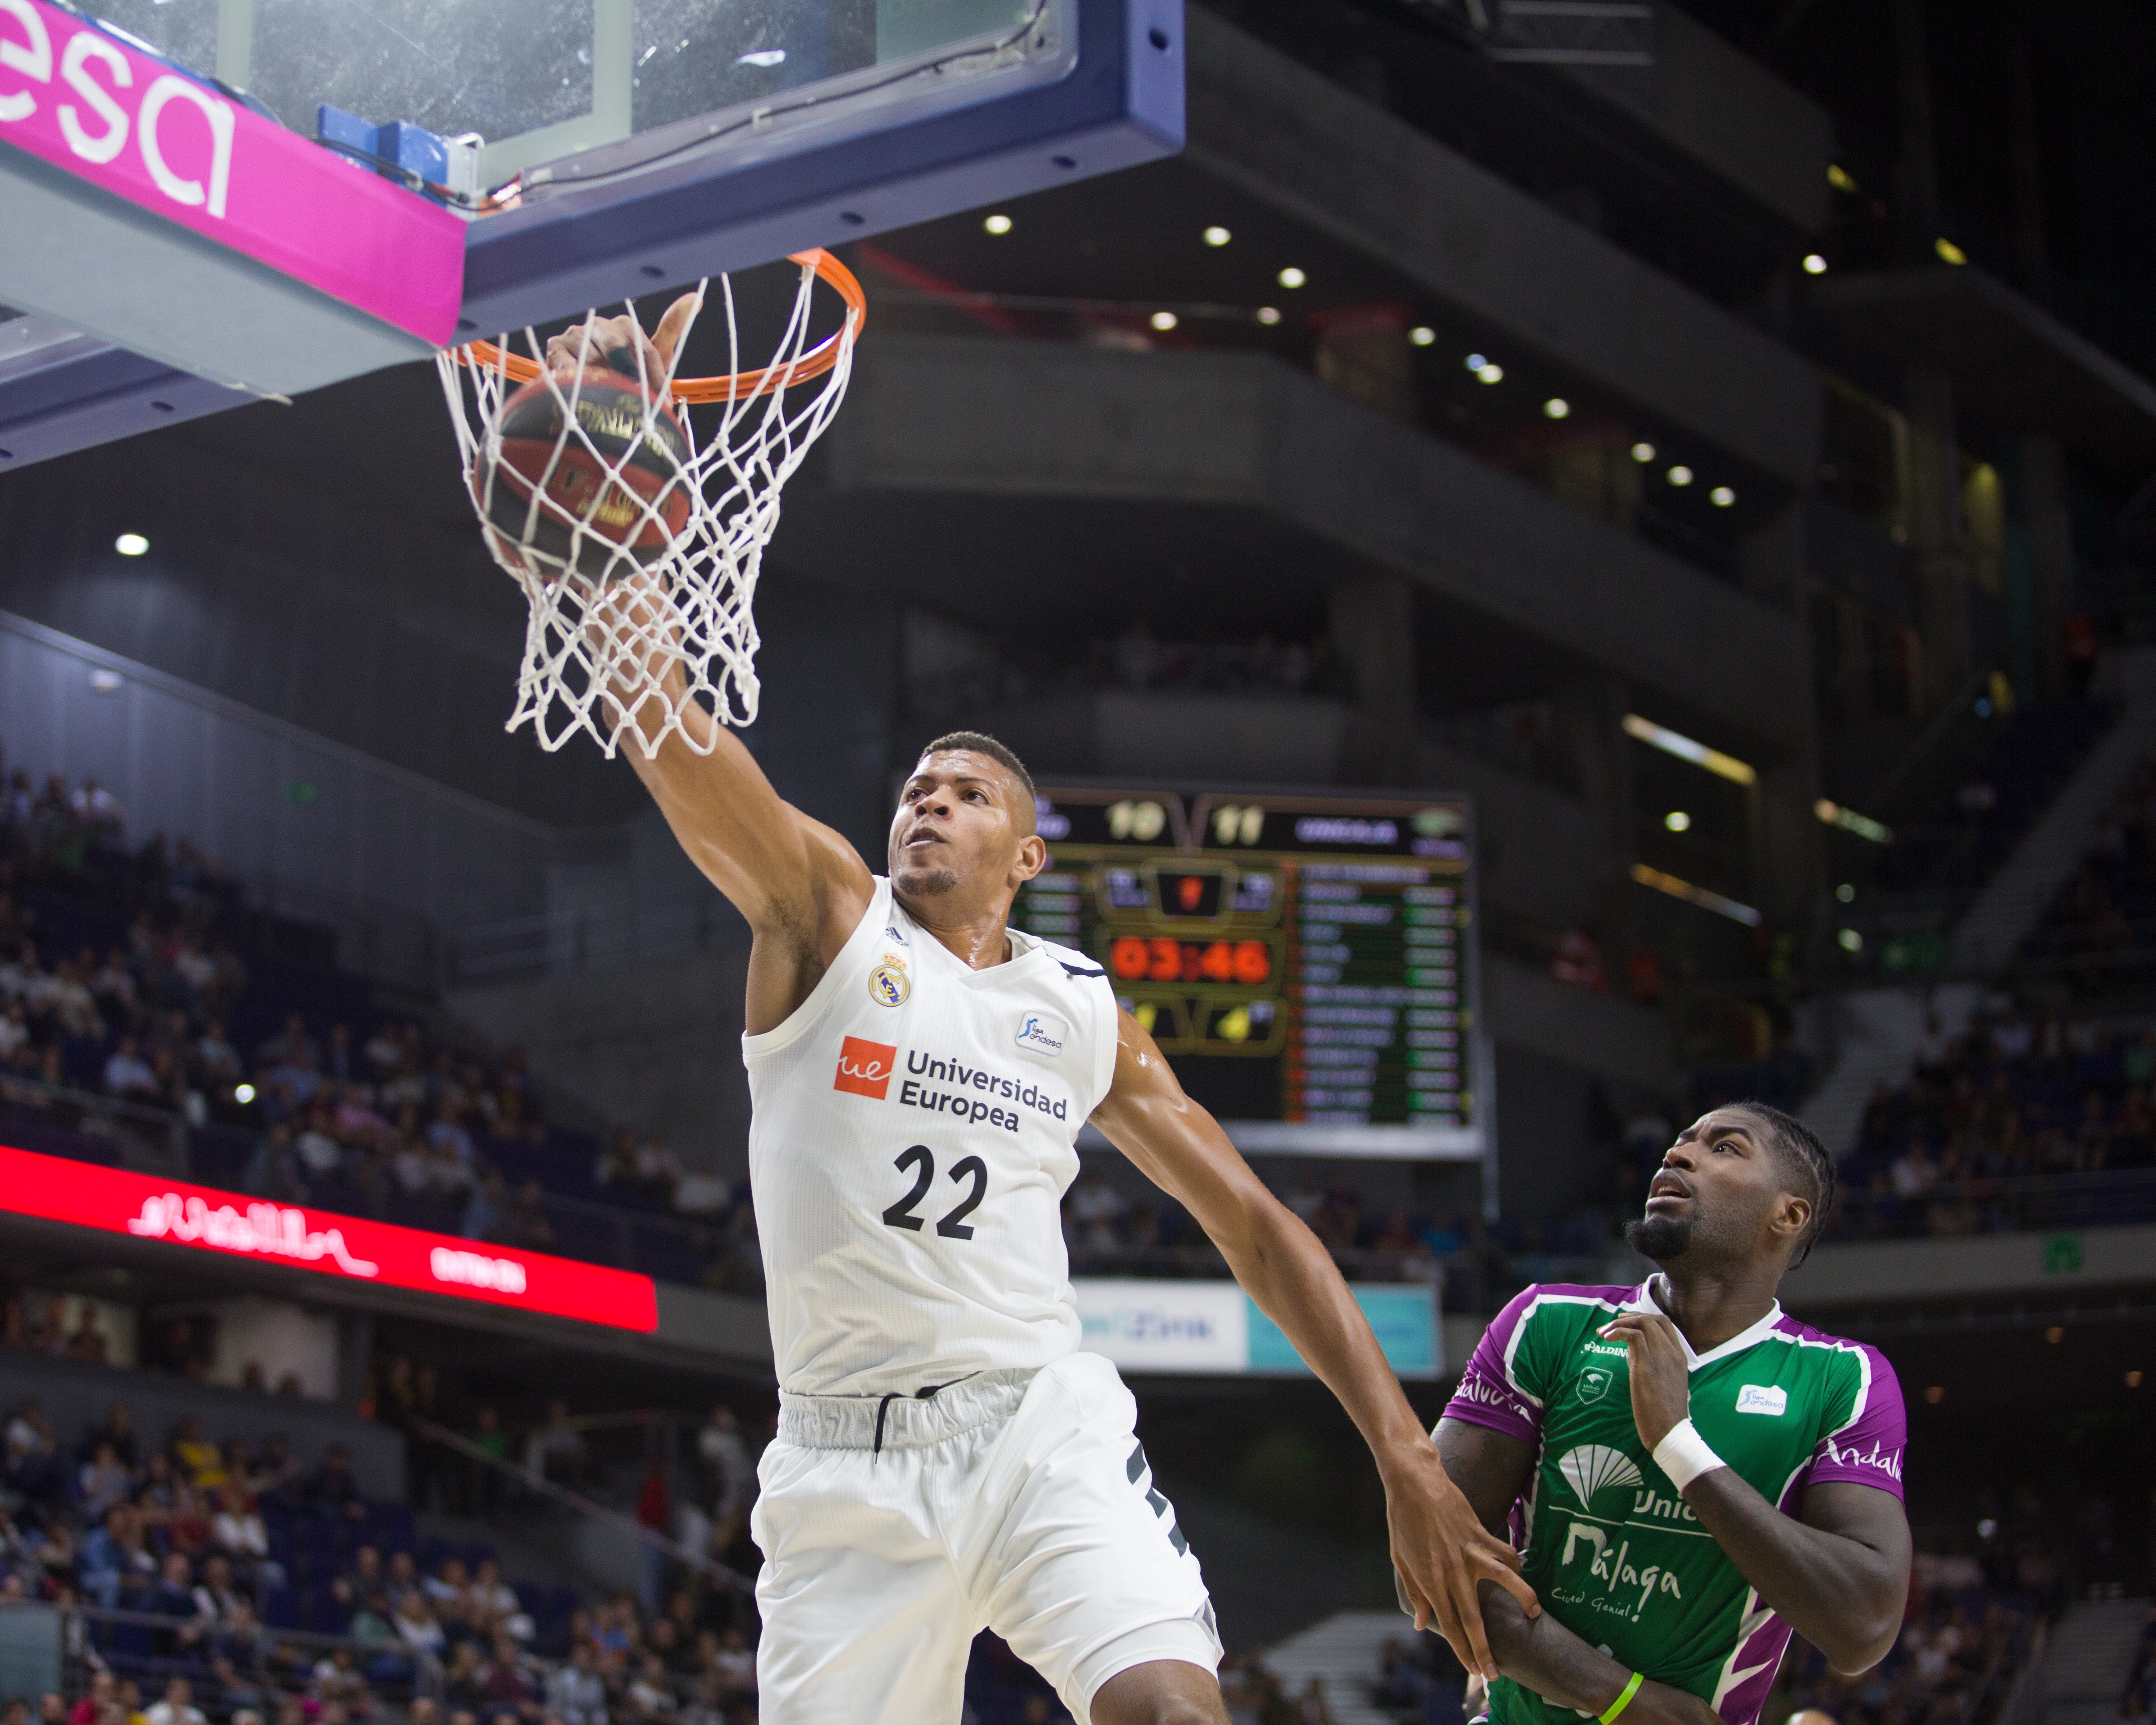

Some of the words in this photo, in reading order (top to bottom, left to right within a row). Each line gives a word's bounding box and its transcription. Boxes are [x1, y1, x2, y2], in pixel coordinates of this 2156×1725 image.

[1030, 1034, 1062, 1048] endesa
[1032, 1023, 1043, 1035] liga
[907, 1050, 1067, 1121] Universidad
[900, 1080, 1019, 1132] Europea
[882, 1145, 988, 1240] 22
[1750, 1400, 1783, 1408] endesa
